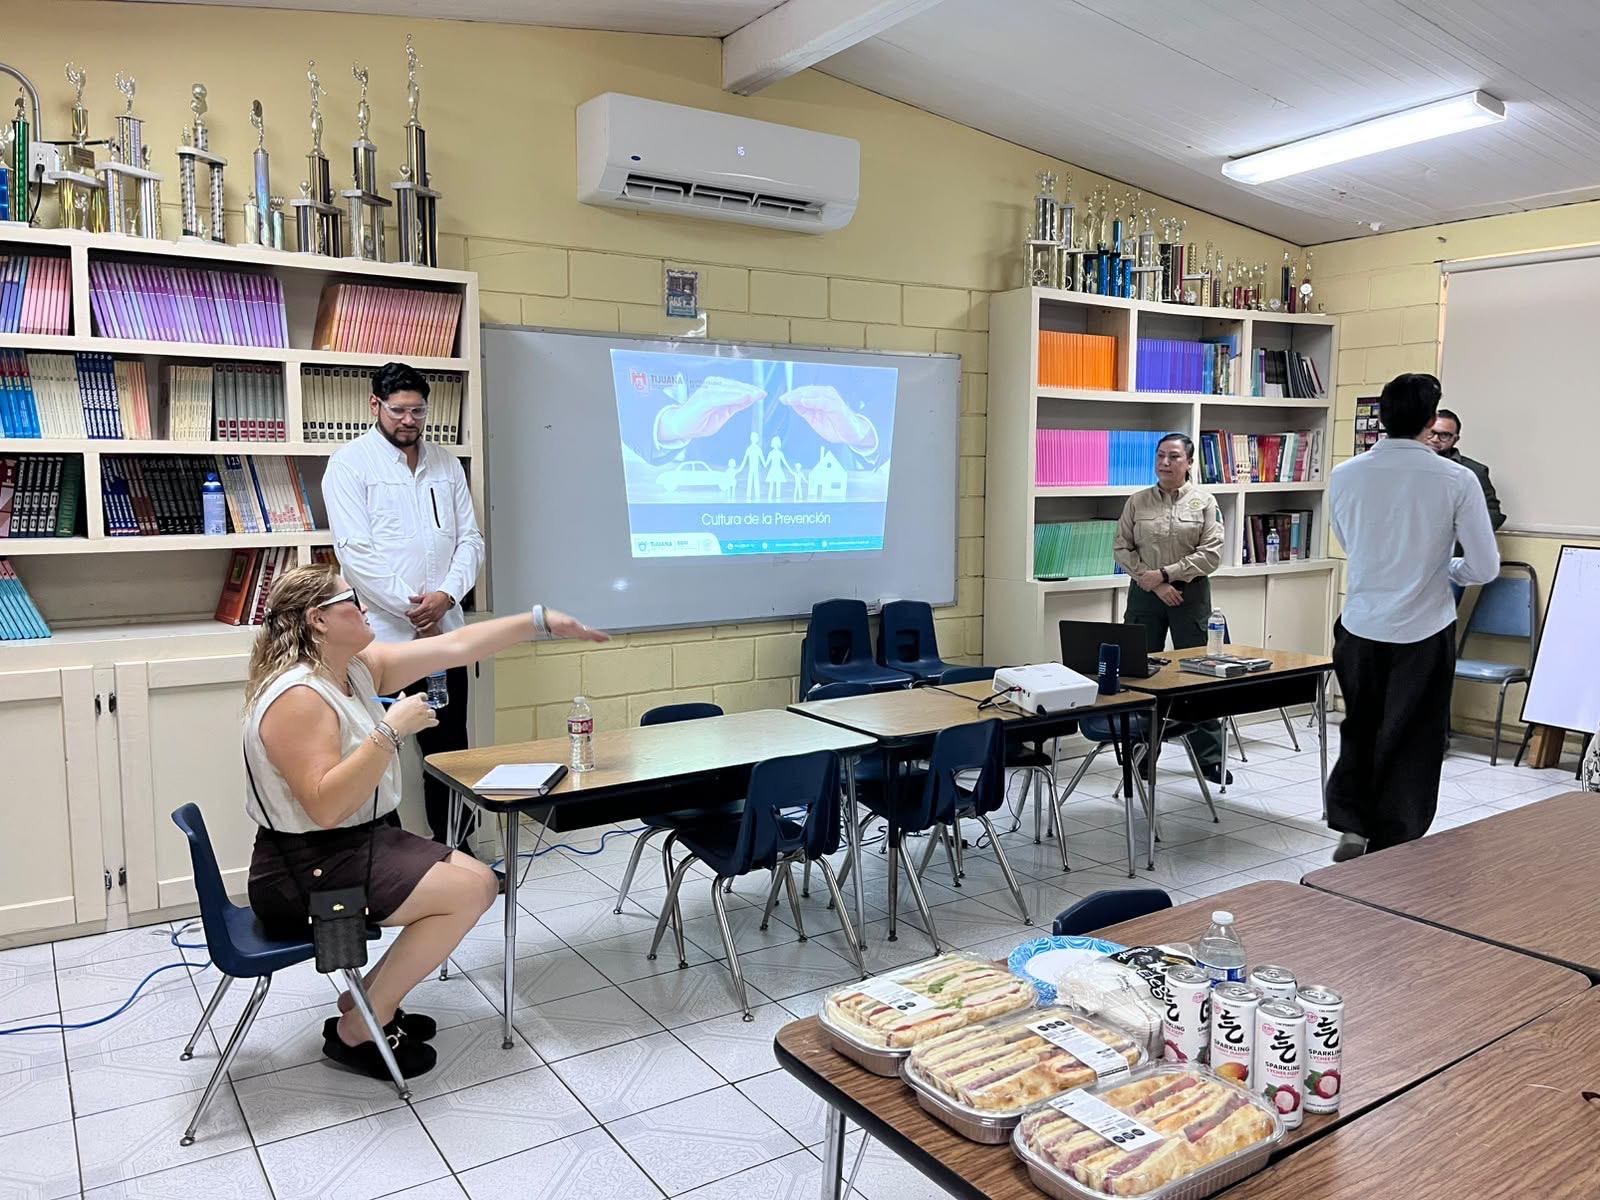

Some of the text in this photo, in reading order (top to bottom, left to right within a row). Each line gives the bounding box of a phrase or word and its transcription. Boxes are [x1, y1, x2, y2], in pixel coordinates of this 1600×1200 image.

[701, 511, 831, 526] Cultura de la Prevención
[1265, 1061, 1300, 1071] SPARKLING
